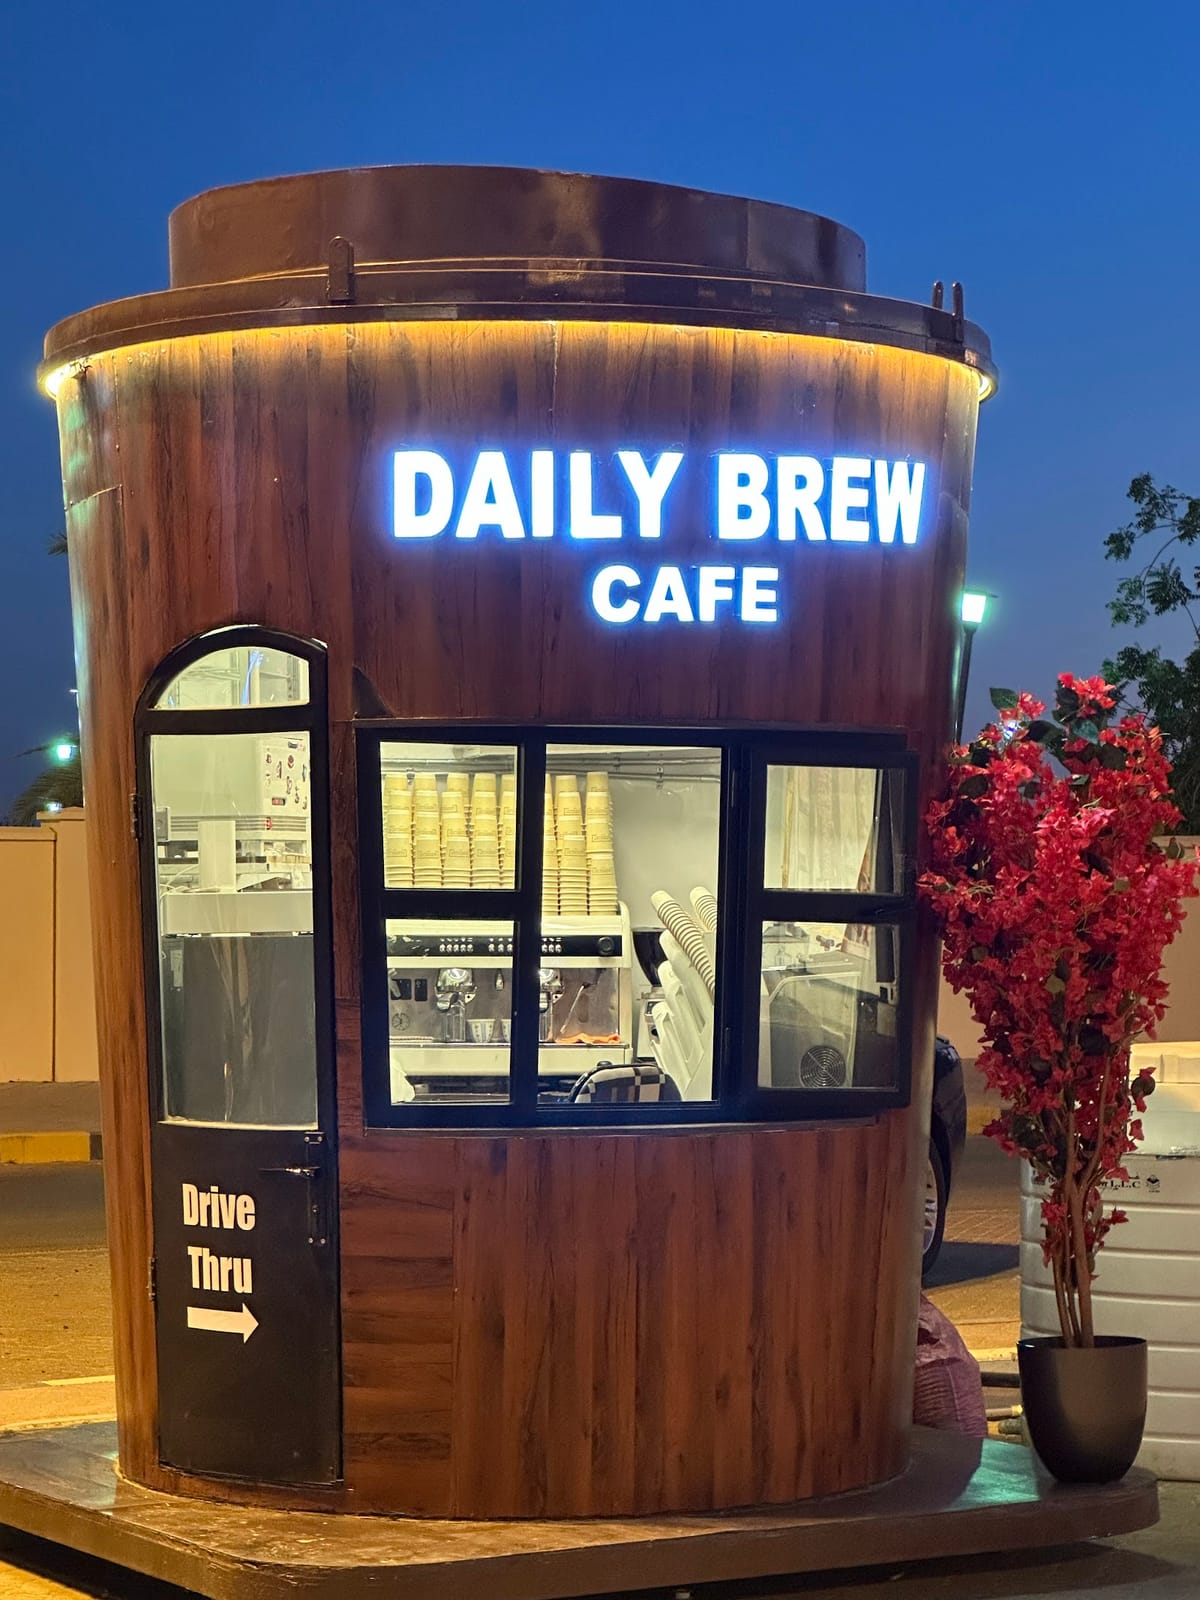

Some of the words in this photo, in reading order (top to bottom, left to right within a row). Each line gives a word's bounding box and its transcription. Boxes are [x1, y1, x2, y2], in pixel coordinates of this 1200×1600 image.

[393, 450, 684, 539] DAILY
[717, 453, 926, 544] BREW
[592, 564, 779, 623] CAFE
[182, 1183, 256, 1231] Drive
[187, 1245, 253, 1294] Thru
